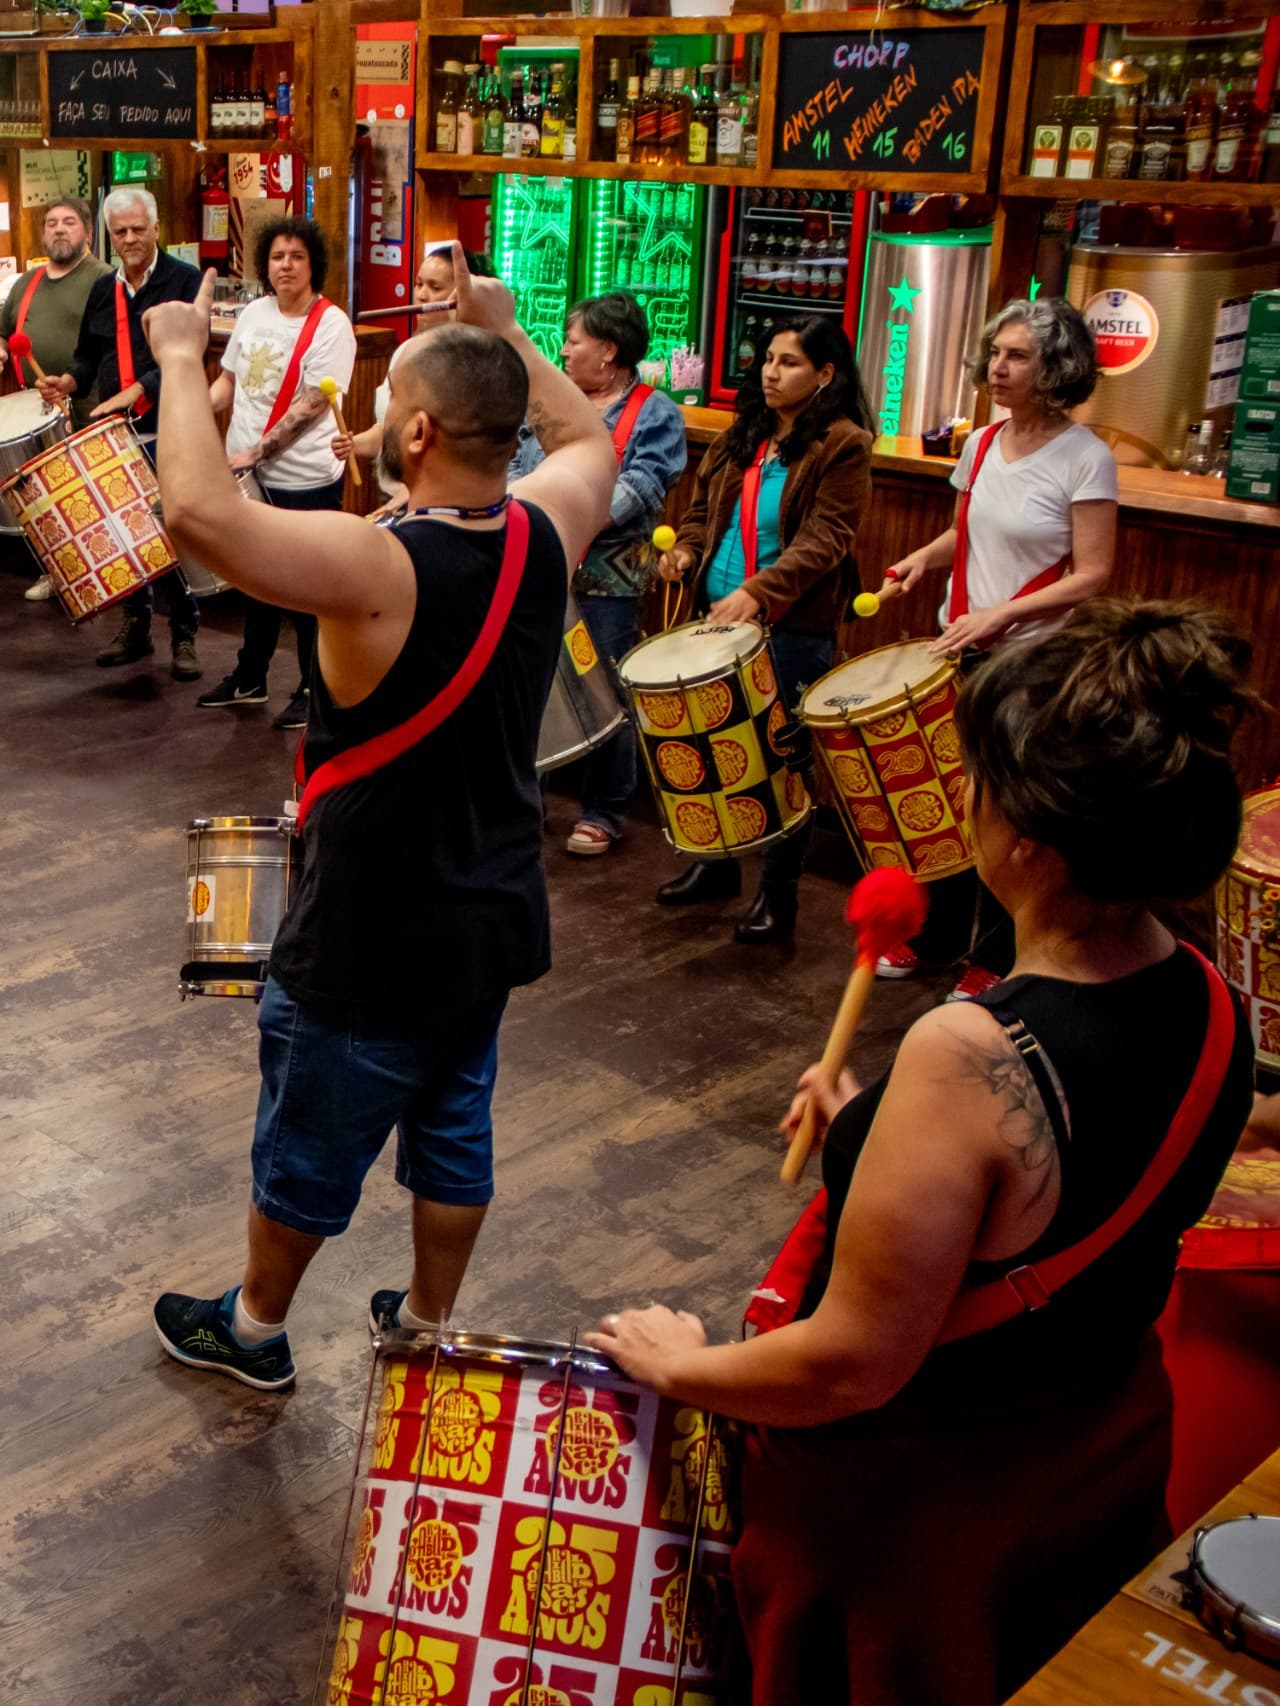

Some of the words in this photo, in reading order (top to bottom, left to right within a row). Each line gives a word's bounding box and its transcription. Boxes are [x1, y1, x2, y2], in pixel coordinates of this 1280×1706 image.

[92, 58, 138, 79] CAIXA
[834, 41, 910, 68] CHOPP
[58, 102, 85, 125] FAÇA
[91, 103, 110, 121] SEU
[120, 105, 159, 123] PEDIDO
[165, 106, 192, 125] AQUI
[783, 78, 854, 151] AMSTEL
[843, 64, 918, 161] HEINEKEN
[952, 69, 980, 105] IPA
[233, 161, 254, 185] 1954
[812, 129, 831, 161] 11
[873, 127, 899, 159] 15
[942, 131, 966, 161] 16
[879, 320, 909, 436] eineken
[421, 1365, 503, 1423] 25
[533, 1380, 640, 1447] 25
[409, 1418, 496, 1485] ANOS
[523, 1437, 632, 1509] ANOS
[399, 1495, 482, 1557] 25
[510, 1516, 619, 1585] 25
[387, 1551, 473, 1619] ANOS
[499, 1574, 611, 1650] ANOS
[374, 1629, 459, 1697] 25
